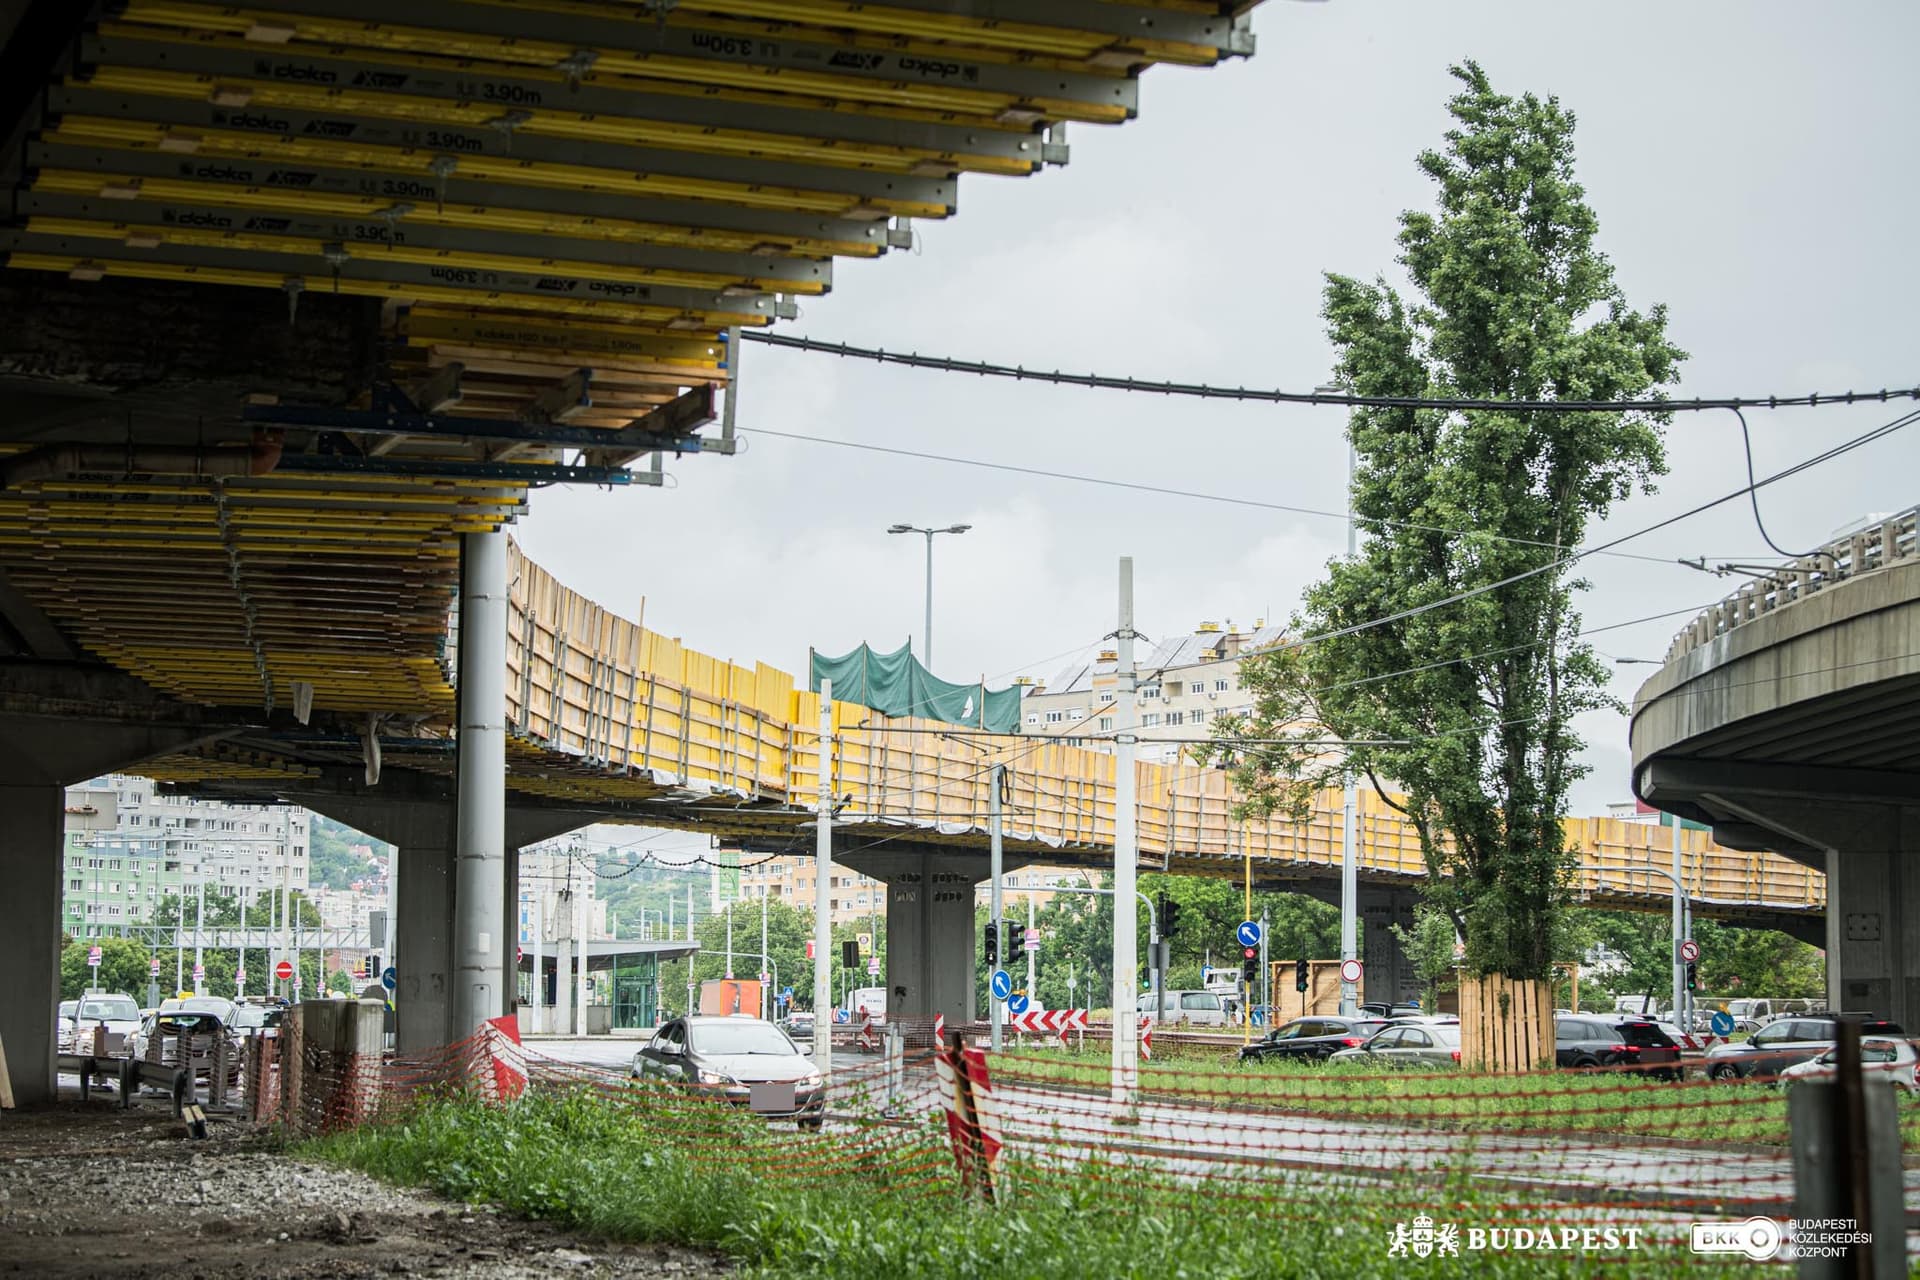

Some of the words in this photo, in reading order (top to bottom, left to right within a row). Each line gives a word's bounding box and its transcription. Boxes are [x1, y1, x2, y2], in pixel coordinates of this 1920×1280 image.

[692, 33, 753, 56] 3.90m
[899, 58, 959, 77] doka
[275, 63, 337, 82] doka
[484, 83, 542, 104] 3.90m
[231, 112, 290, 131] doka
[427, 131, 482, 150] 3.90m
[197, 166, 252, 181] doka
[383, 181, 436, 198] 3.90m
[180, 212, 232, 227] doka
[431, 268, 477, 283] 3.90m
[590, 283, 636, 297] doka
